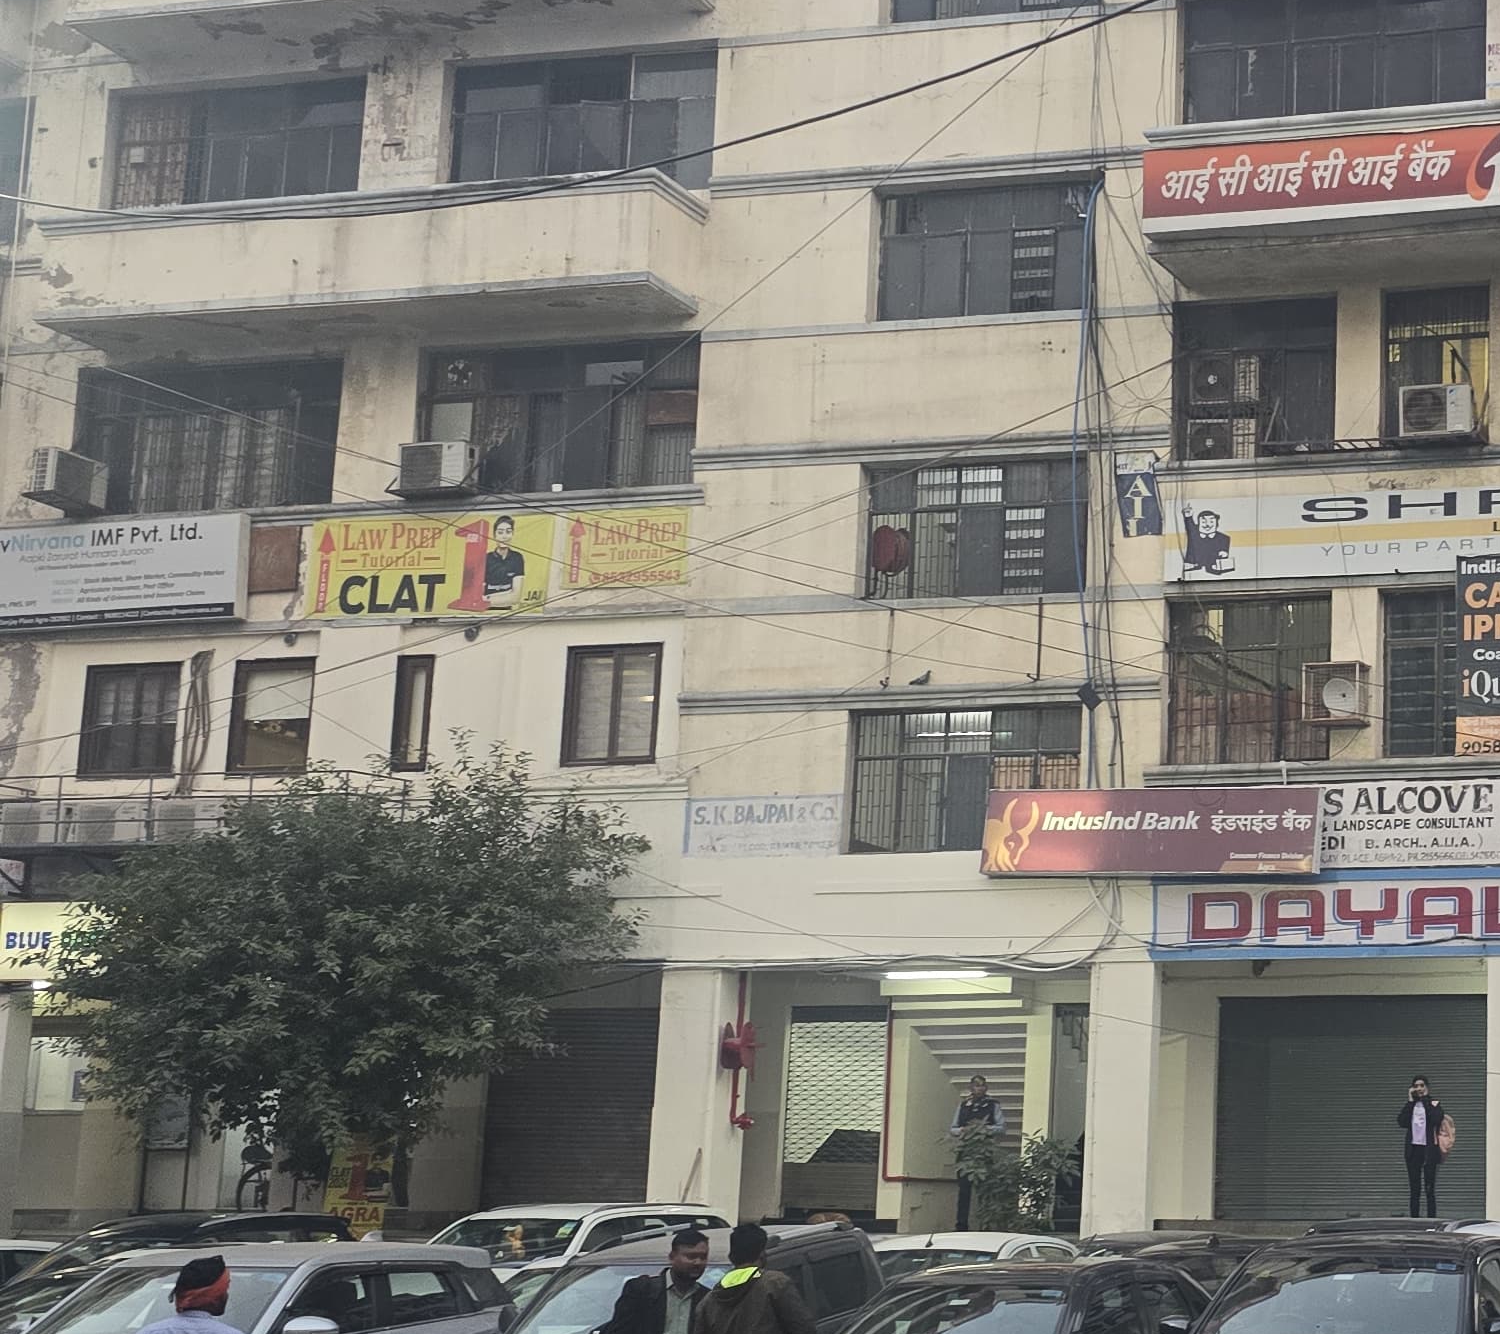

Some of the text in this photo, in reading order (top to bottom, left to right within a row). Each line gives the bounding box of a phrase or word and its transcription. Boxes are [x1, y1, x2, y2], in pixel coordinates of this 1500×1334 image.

[1161, 138, 1456, 204] आई सी आई सी आई बैंक
[91, 522, 203, 547] IMF Pvt. Ltd.
[343, 522, 442, 551] LAW PREP
[592, 518, 682, 546] LAW PREP
[361, 551, 421, 568] Tutorial
[609, 545, 663, 562] Tutorial
[1320, 541, 1400, 557] YOUR
[339, 573, 446, 615] CLAT
[1351, 783, 1494, 815] ALCOVE
[1041, 810, 1200, 832] IndusInd Bank
[1210, 809, 1280, 835] इंडसइंड
[1281, 808, 1314, 832] बैंक
[1333, 818, 1411, 832] LANDSCAPE
[1416, 816, 1495, 830] CONSULTANT
[6, 931, 52, 950] BLUE
